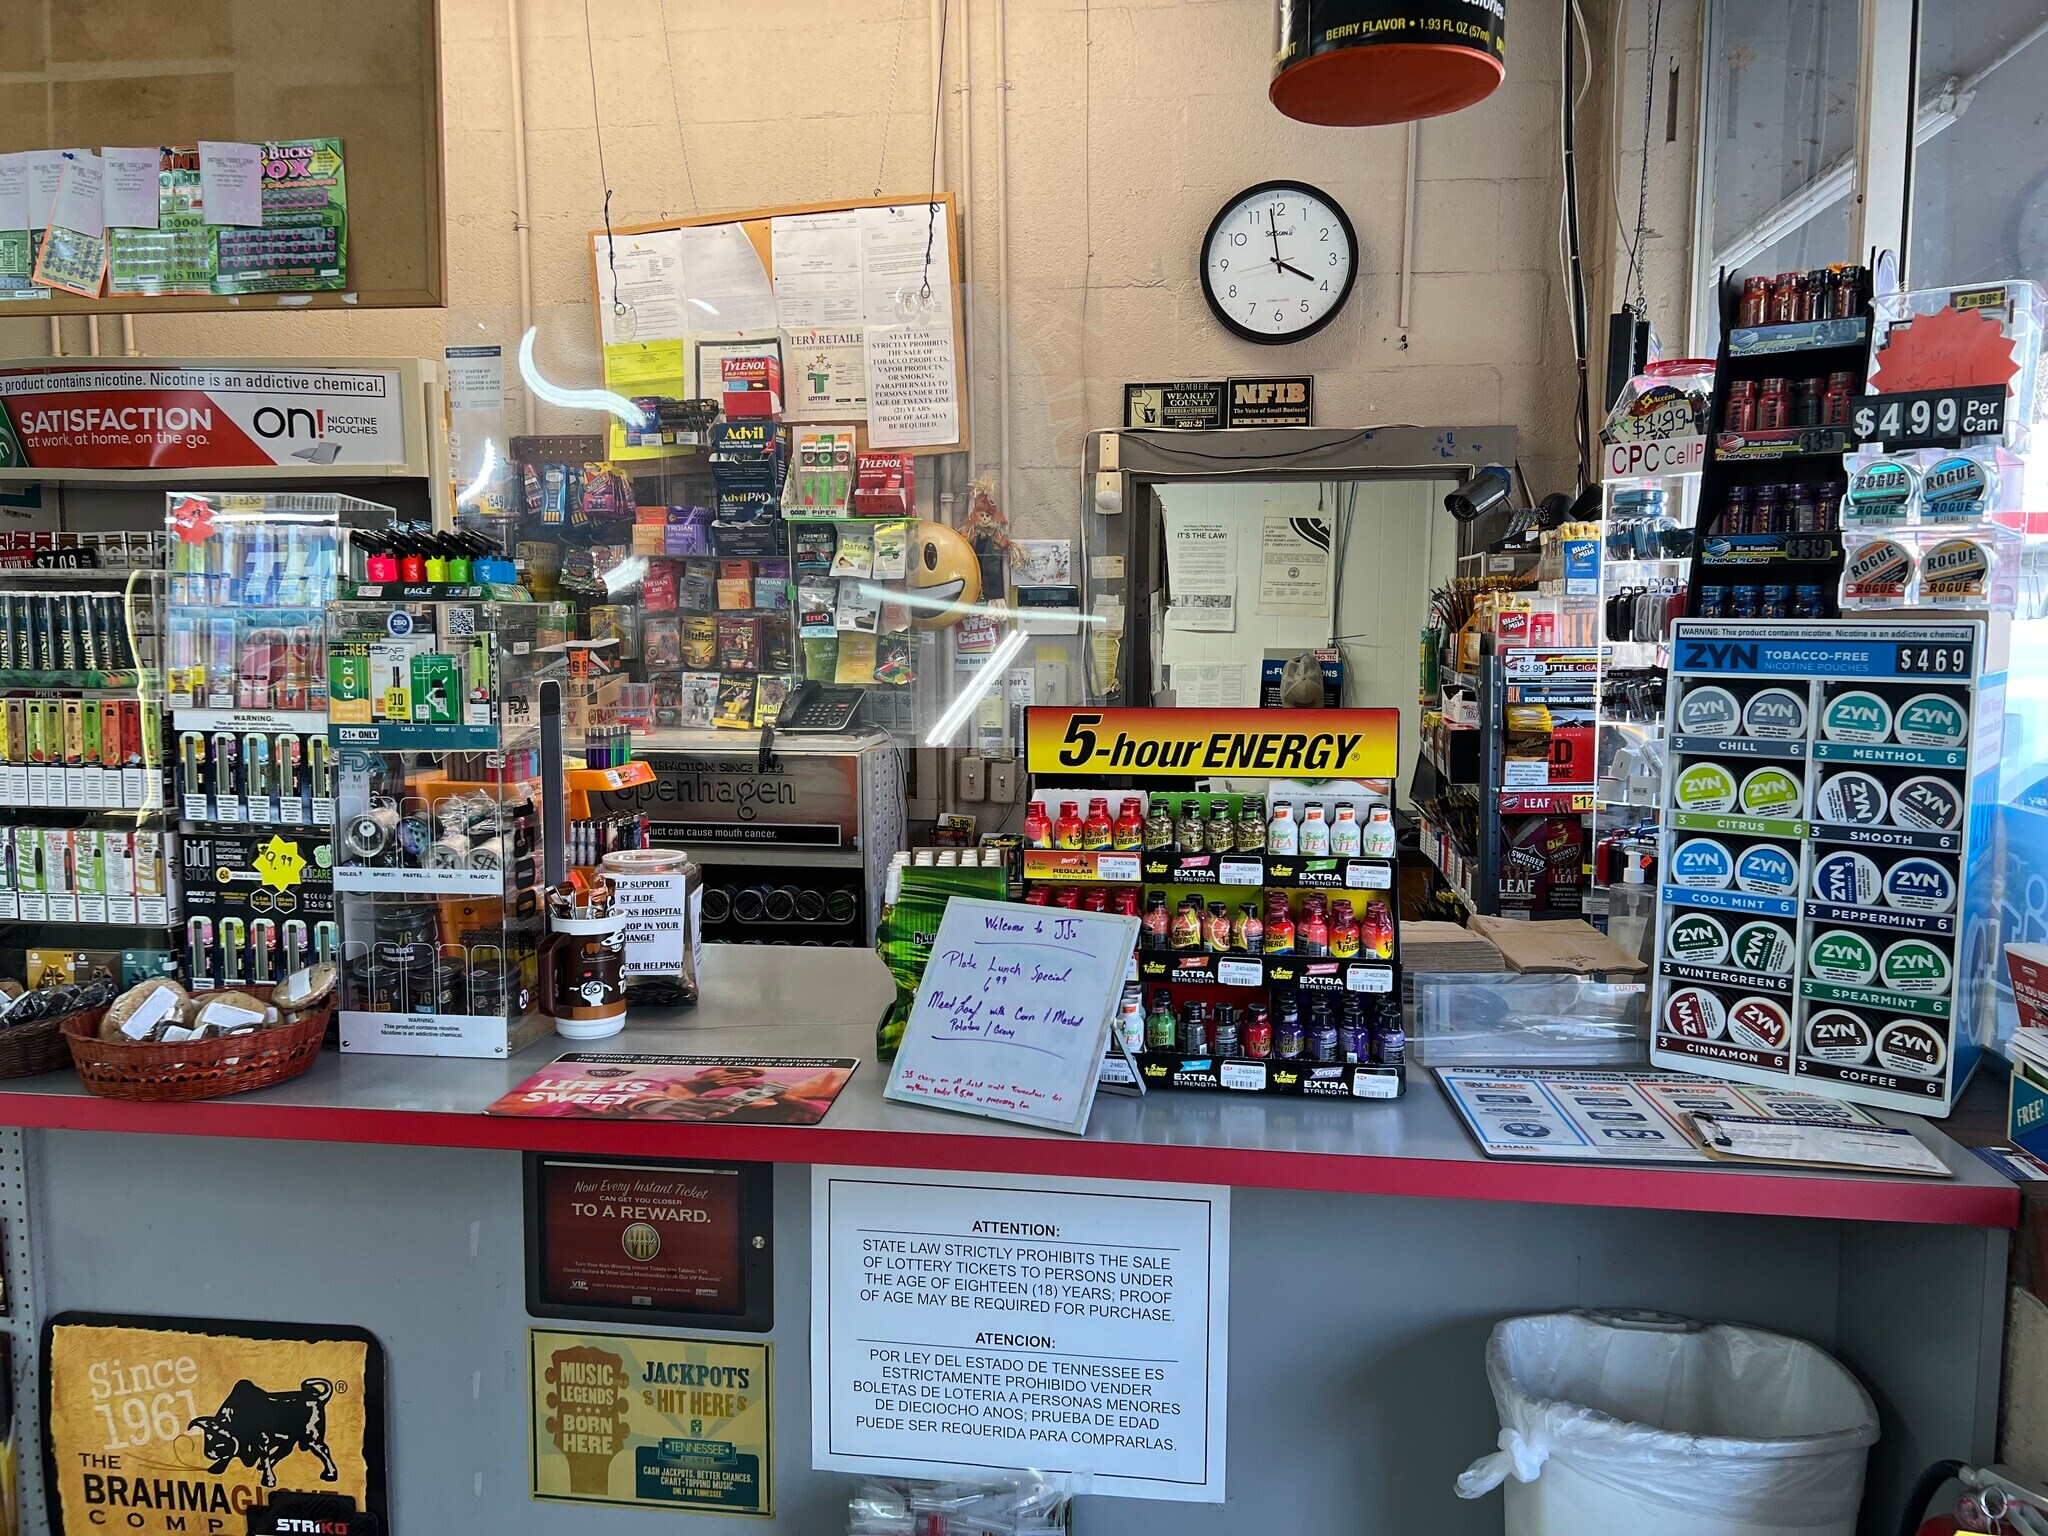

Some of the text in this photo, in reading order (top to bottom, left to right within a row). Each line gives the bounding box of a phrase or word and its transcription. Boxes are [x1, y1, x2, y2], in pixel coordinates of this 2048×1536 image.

[1326, 18, 1468, 41] BERRY FLAVOR 1.93 FL OZ
[269, 146, 313, 158] BUCKS
[1271, 202, 1286, 216] 12
[1329, 253, 1338, 266] 3
[872, 341, 907, 349] STRICTLY
[724, 360, 766, 373] TYLENOL
[5, 373, 382, 393] product contains nicotine. Nicotine is an addictive chemical.
[1173, 383, 1209, 391] MEMBER
[1167, 391, 1216, 400] WEAKLEY
[1235, 383, 1305, 404] NFIB
[1966, 400, 1998, 417] Per
[21, 407, 212, 435] SATISFACTION
[253, 406, 324, 440] on!
[327, 416, 377, 426] NICOTINE
[1178, 420, 1203, 428] 2021-22
[1853, 397, 1957, 439] $4.99
[1963, 416, 1998, 433] Can
[328, 425, 378, 434] POUCHES
[724, 426, 765, 441] Advil
[28, 431, 210, 449] at work, at home, on the go.
[859, 458, 901, 469] TYLENOL
[1612, 443, 1659, 474] CPC
[1716, 452, 1782, 461] RHINO RUSH
[1857, 505, 1897, 516] ROGUE
[1931, 501, 1972, 513] ROGUE
[404, 587, 432, 595] EAGLE
[1681, 628, 1720, 636] WARNING:
[1738, 629, 1766, 638] product
[1801, 629, 1833, 637] nicotine.
[1836, 629, 1868, 637] Nicotine
[1870, 630, 1876, 638] is
[1891, 630, 1926, 639] addictive
[1928, 630, 1969, 639] chemical.
[1685, 643, 1760, 669] ZYN
[1765, 651, 1869, 662] TOBACCO-FREE
[1519, 665, 1544, 673] $2.99
[1765, 662, 1869, 672] NICOTINE POUCHES
[1059, 714, 1363, 769] 5-hour ENERGY
[1719, 741, 1757, 751] CHILL
[1853, 749, 1925, 762] MENTHOL
[1524, 798, 1550, 808] LEAF
[715, 829, 777, 838] mouth cancer.
[1717, 819, 1765, 832] CITRUS
[1850, 831, 1913, 846] SMOOTH
[1511, 850, 1545, 868] SWISHER
[1174, 869, 1214, 878] EXTRA
[630, 880, 670, 889] SUPPORT
[620, 894, 654, 902] ST JUDE
[1691, 892, 1765, 910] COOL MINT
[642, 907, 682, 916] HOSPITAL
[1831, 908, 1926, 930] PEPPERMINT
[985, 916, 1083, 940] Welcome to JJ's
[644, 961, 683, 970] HELPING!
[943, 951, 1072, 982] Plate Lunch Special
[1677, 966, 1776, 988] WINTERGREEN
[1831, 988, 1917, 1009] SPEARMINT
[1686, 1042, 1759, 1064] CINNAMON
[1314, 1067, 1343, 1078] Grape
[1840, 1069, 1897, 1088] COFFEE
[533, 1079, 650, 1091] LIFE IS
[521, 1093, 638, 1105] SWEET
[574, 1180, 708, 1200] Now Every Instant Ticket
[572, 1203, 711, 1223] TO A REWARD.
[972, 1221, 1060, 1237] ATTENTION:
[863, 1239, 1170, 1270] STATE LAW STRICTLY PROHIBITS THE SALE
[863, 1256, 1173, 1287] OF LOTTERY TICKETS TO PERSONS UNDER
[976, 1332, 1056, 1349] ATENCION:
[89, 1356, 198, 1400] Since
[560, 1362, 614, 1387] MUSIC
[642, 1361, 749, 1389] JACKPOTS
[560, 1385, 614, 1406] LEGENDS
[657, 1389, 734, 1418] HIT HERE
[95, 1389, 205, 1451] 1961
[563, 1414, 613, 1434] BORN
[563, 1434, 613, 1455] HERE
[670, 1442, 724, 1455] TENNESSEE
[78, 1452, 122, 1469] THE
[276, 1518, 347, 1534] STRIKO
